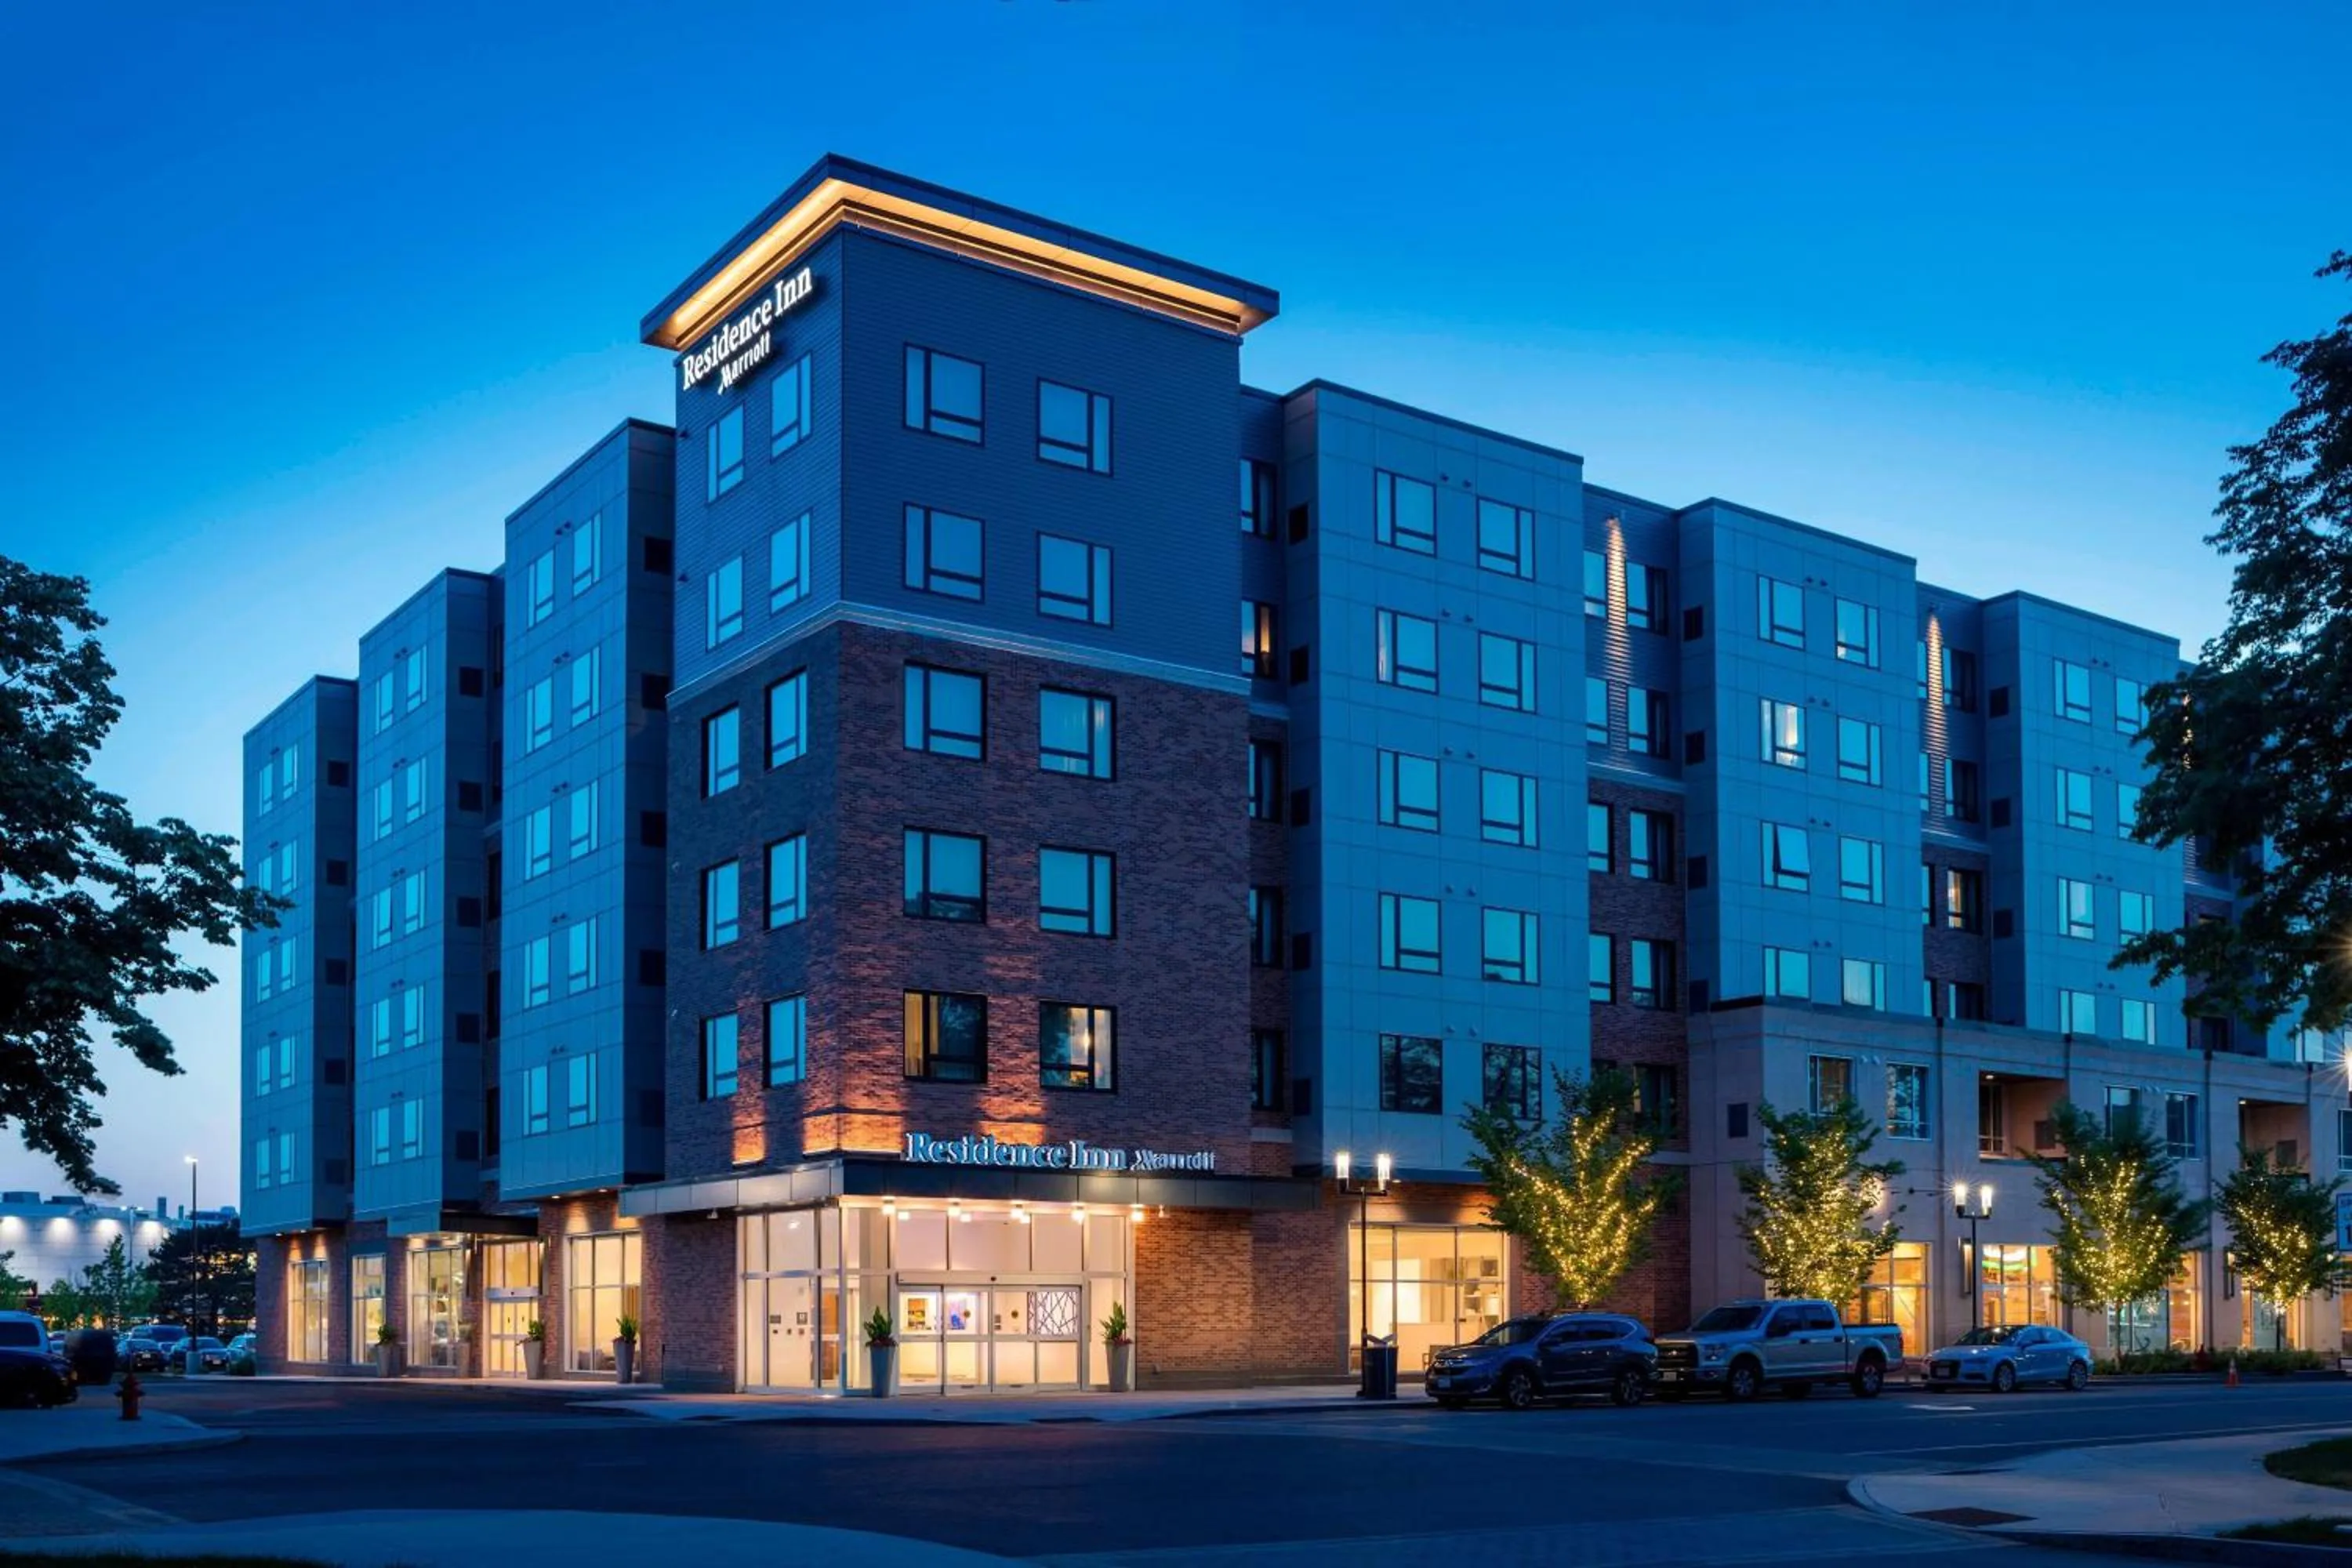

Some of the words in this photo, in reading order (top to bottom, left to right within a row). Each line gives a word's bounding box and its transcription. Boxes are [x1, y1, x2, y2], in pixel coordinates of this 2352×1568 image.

[683, 299, 772, 390] Residence
[775, 267, 812, 317] Inn
[717, 331, 771, 395] Marriott
[906, 1131, 1067, 1168] Residence
[1069, 1139, 1128, 1170] Inn
[1130, 1149, 1216, 1172] Marriott
